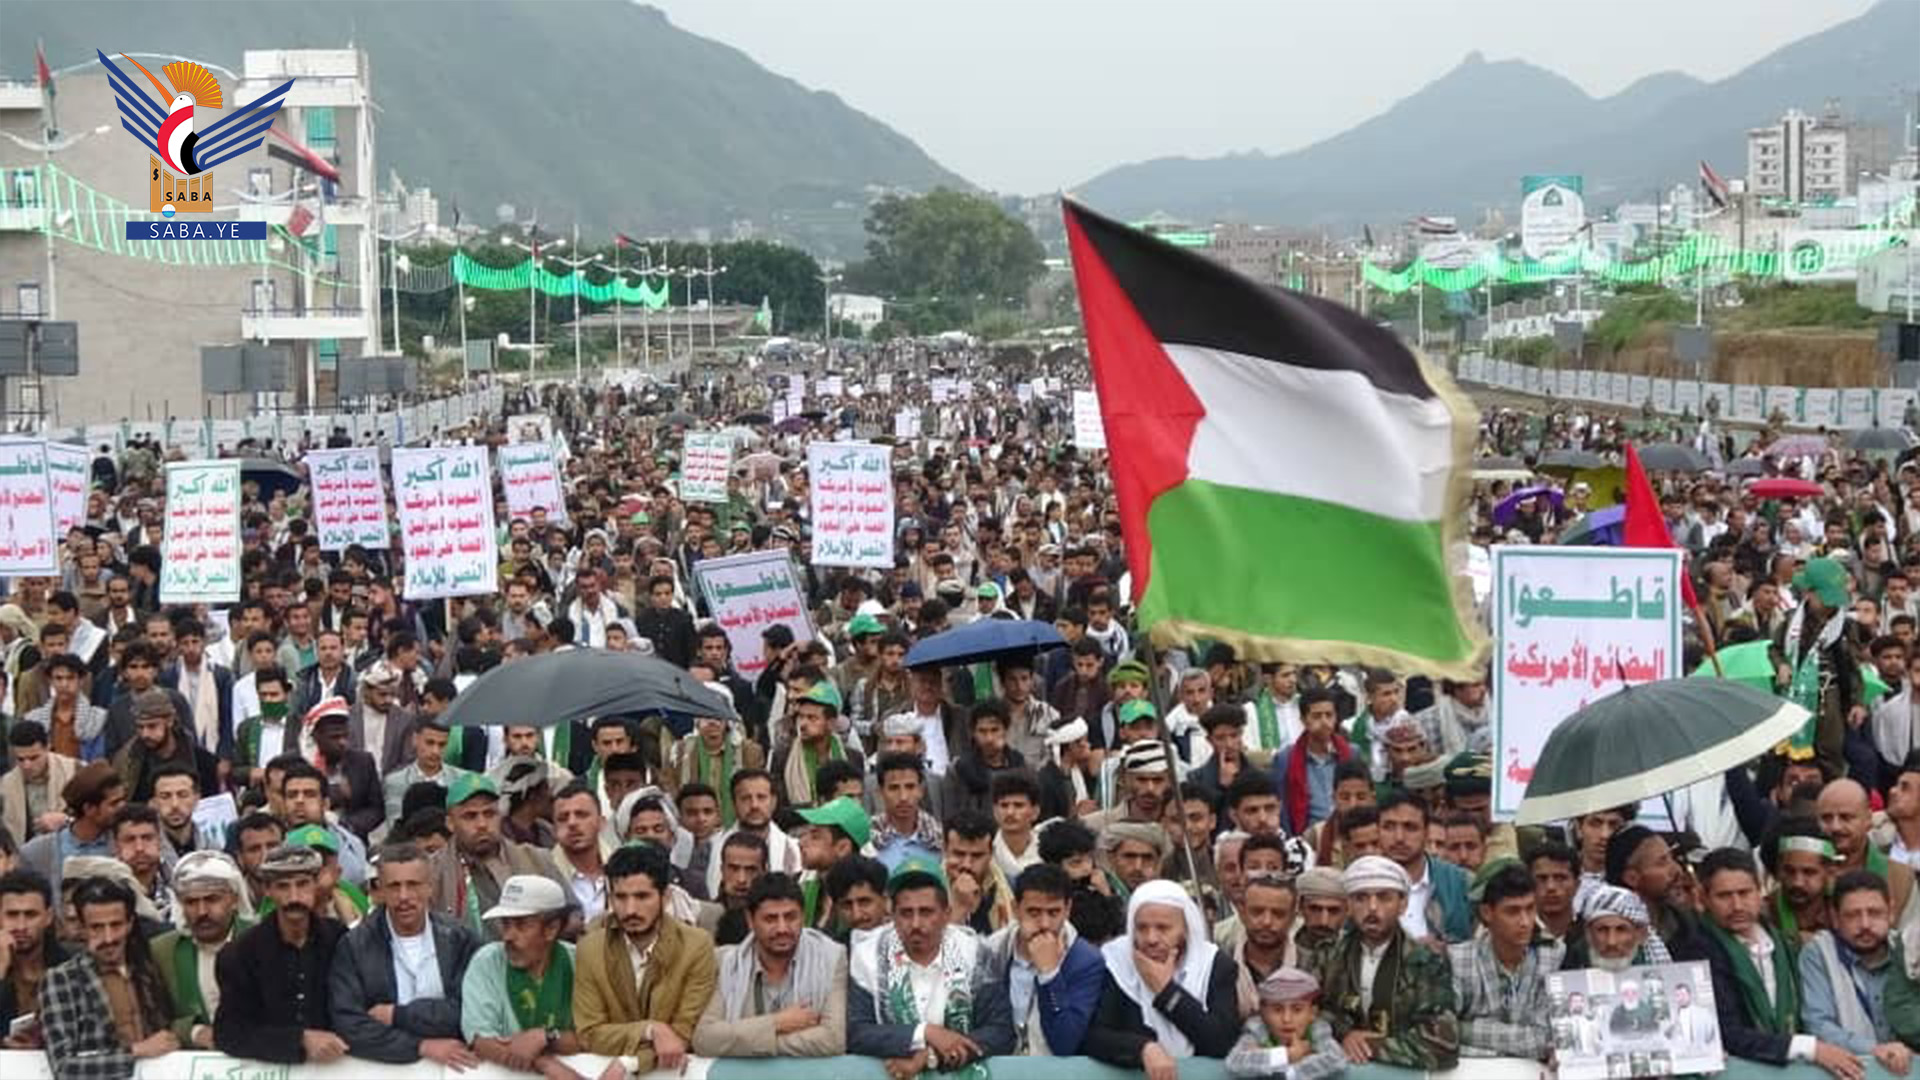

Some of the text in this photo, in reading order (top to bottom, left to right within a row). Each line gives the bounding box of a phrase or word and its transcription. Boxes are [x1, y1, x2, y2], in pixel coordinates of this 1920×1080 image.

[708, 568, 791, 605] قاطعوا
[1507, 575, 1666, 628] قاطعوا
[1507, 638, 1665, 688] البضائع الأمريكية
